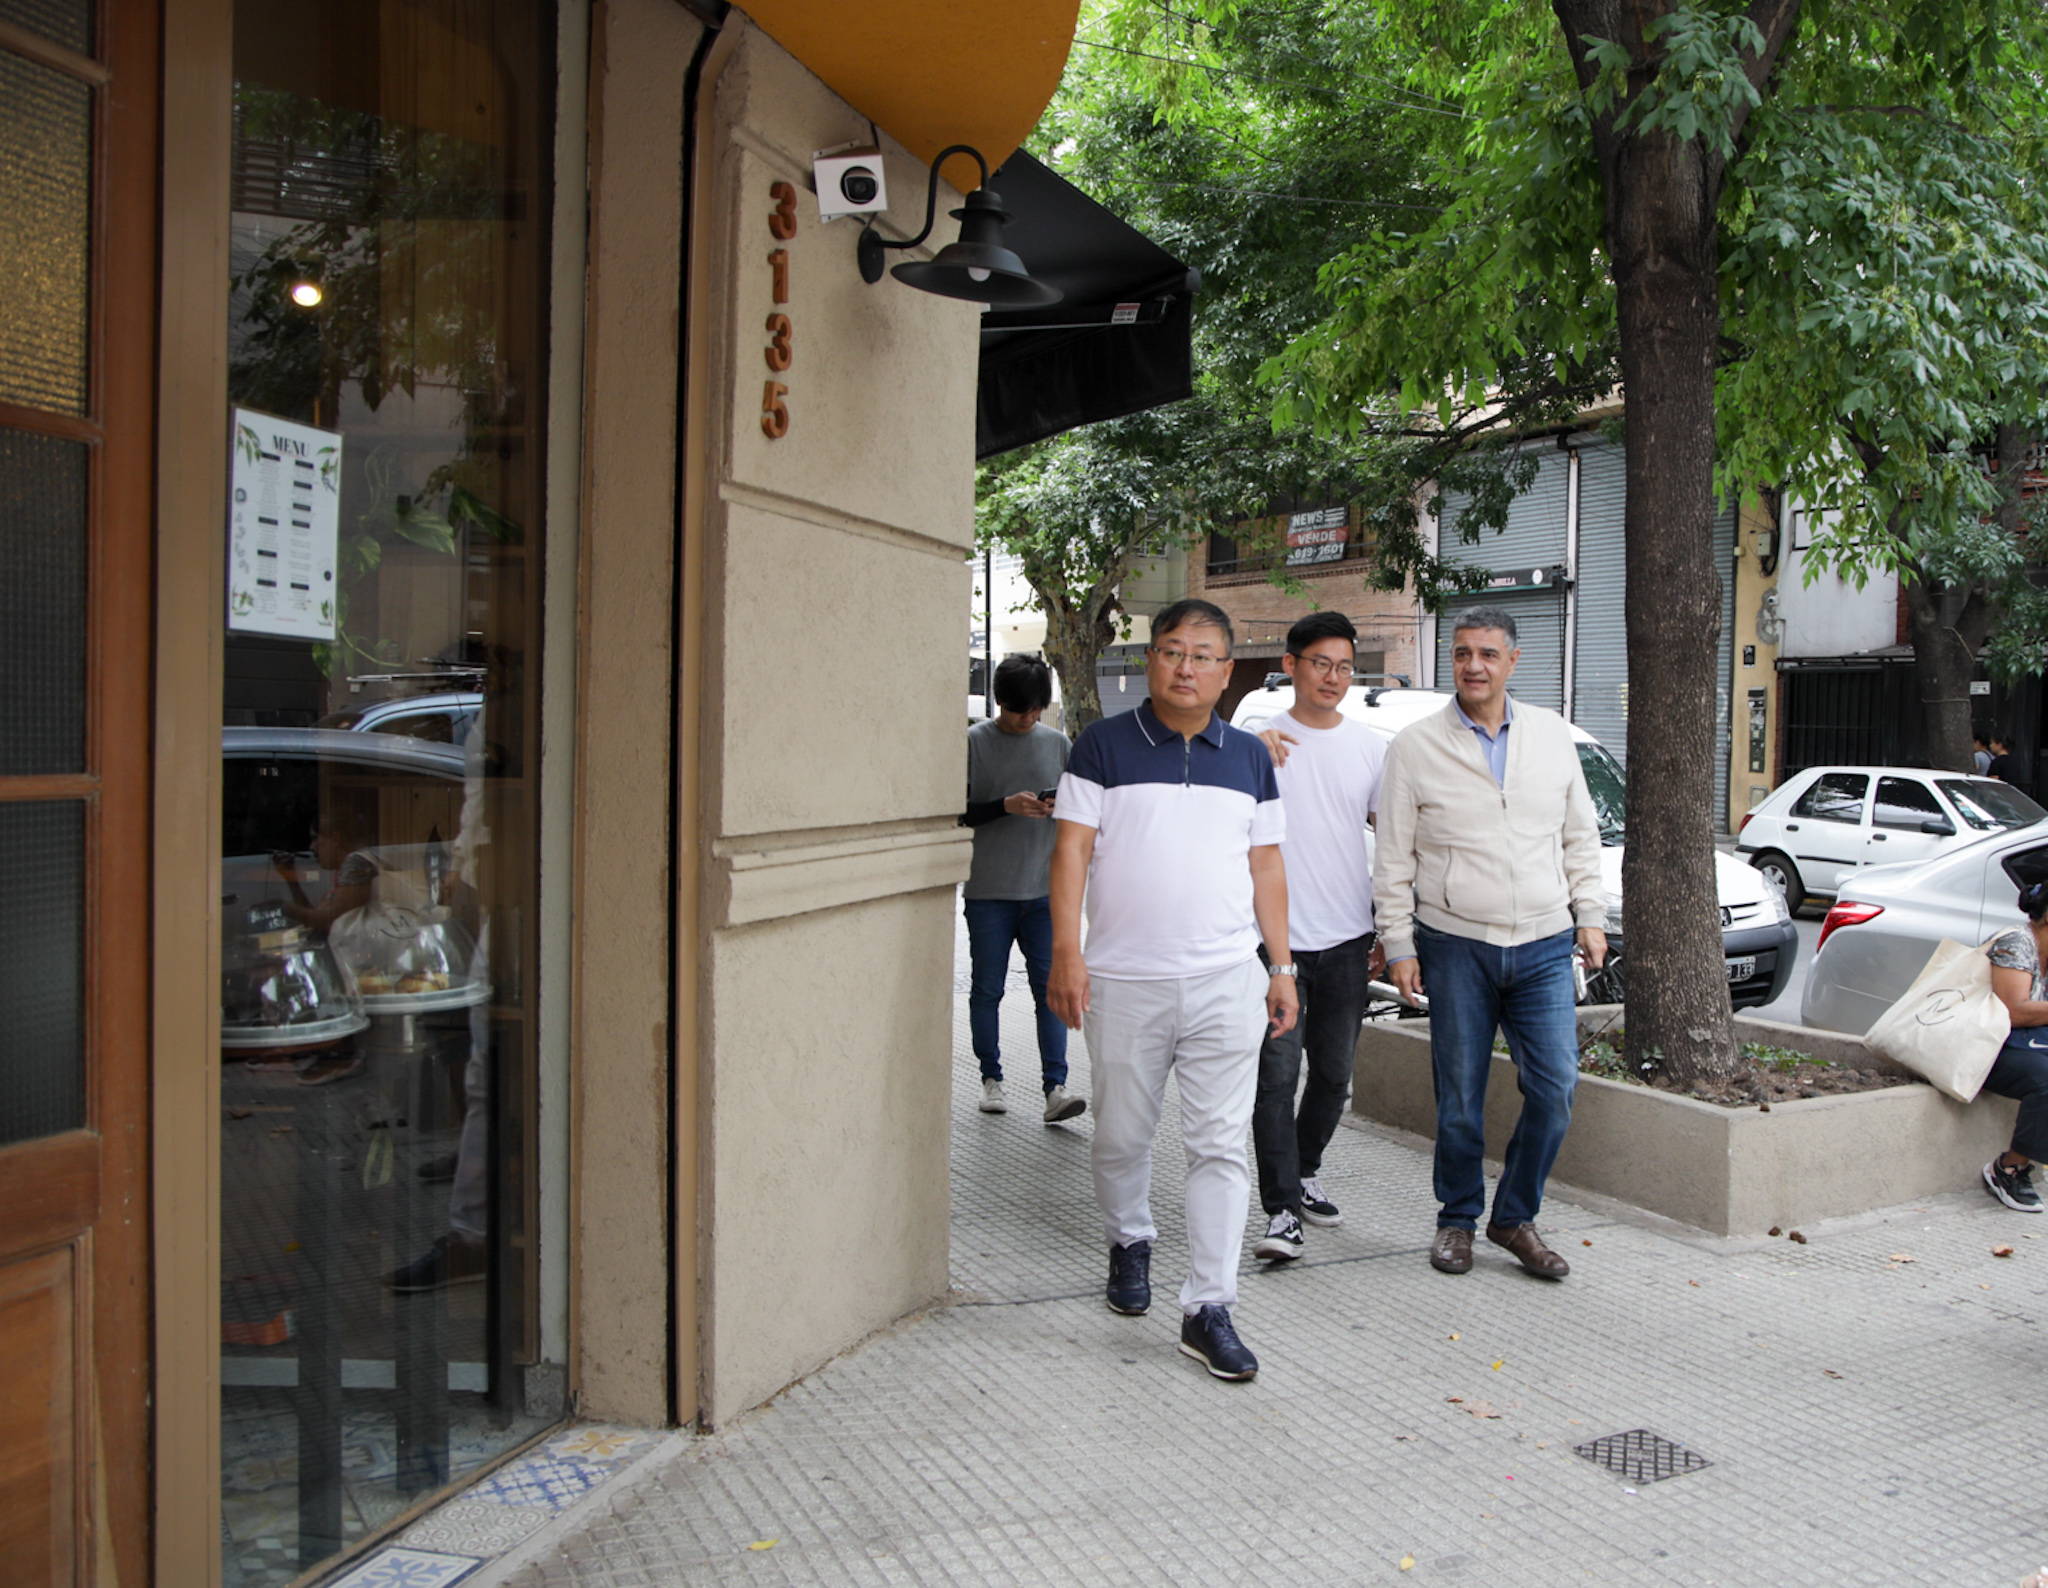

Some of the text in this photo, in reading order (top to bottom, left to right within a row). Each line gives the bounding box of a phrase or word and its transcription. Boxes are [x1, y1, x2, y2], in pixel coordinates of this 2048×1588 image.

[761, 181, 797, 439] 3135
[273, 434, 310, 458] MENU
[1292, 510, 1324, 527] NEWS
[1297, 529, 1337, 545] VENDE
